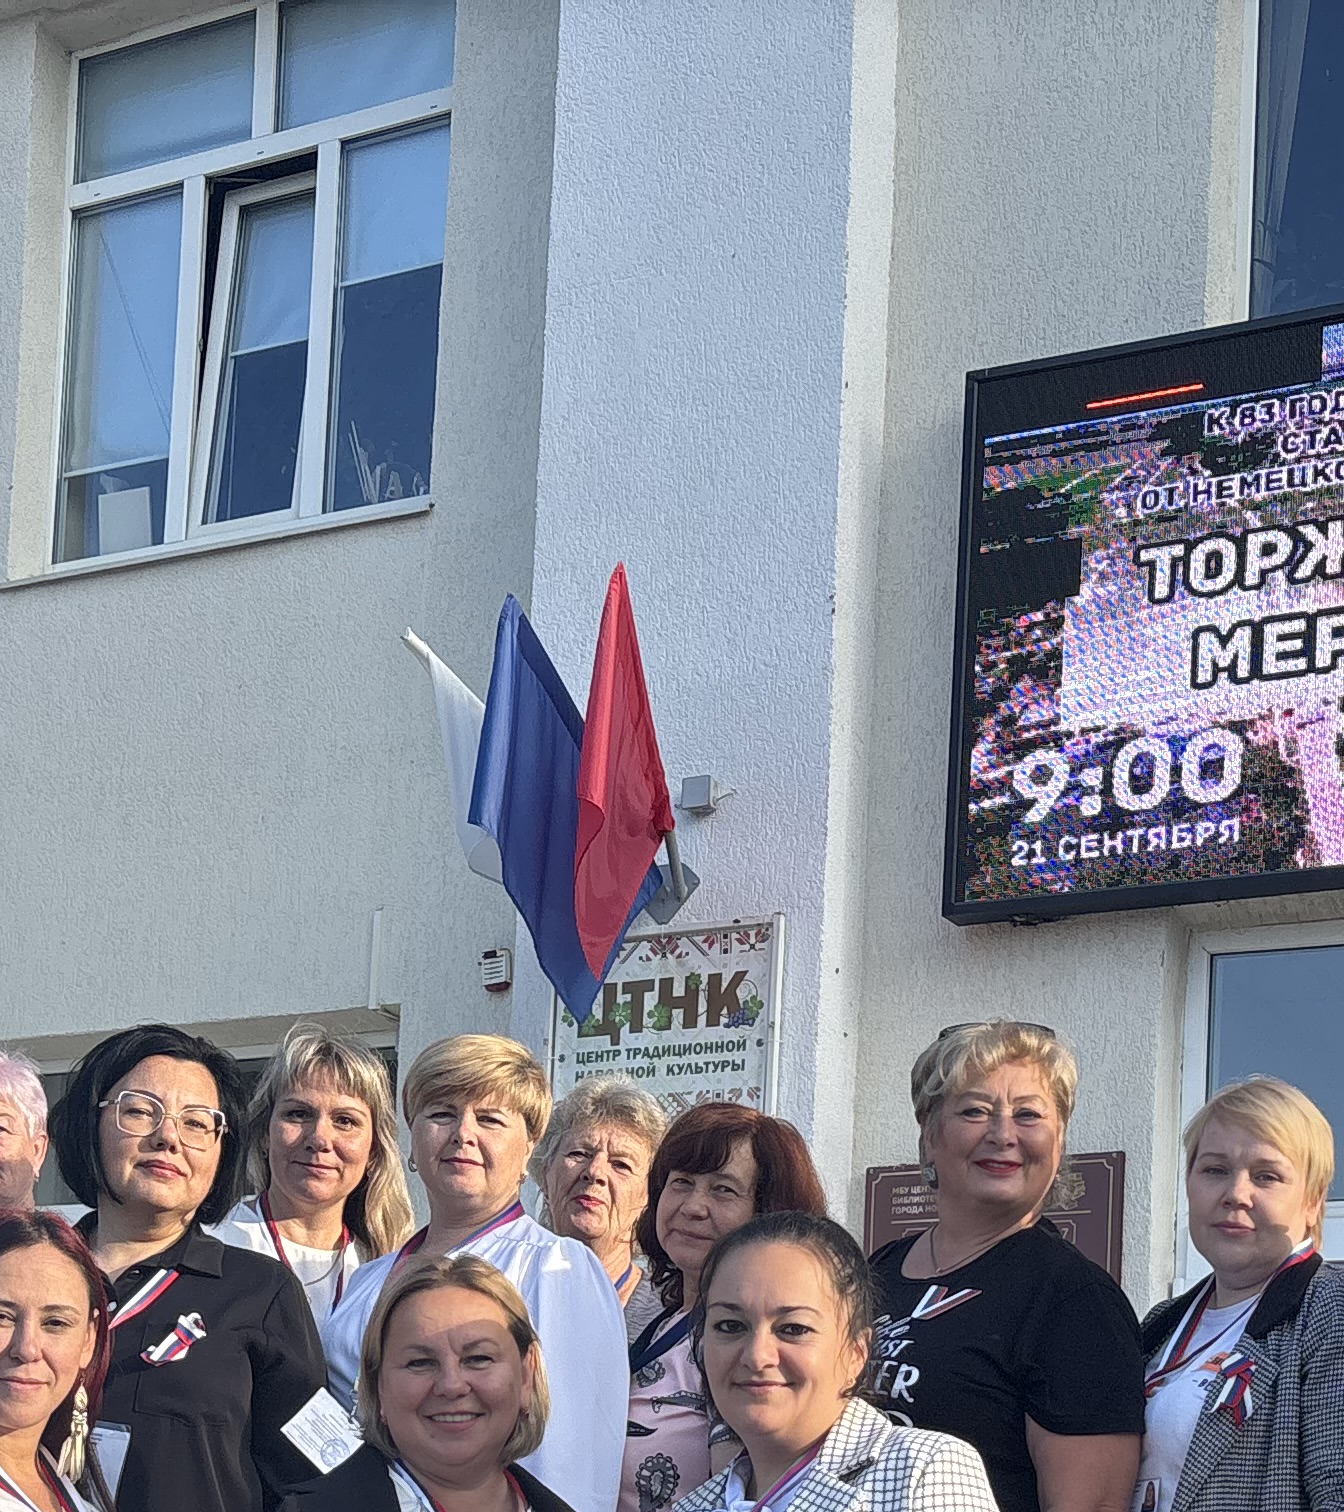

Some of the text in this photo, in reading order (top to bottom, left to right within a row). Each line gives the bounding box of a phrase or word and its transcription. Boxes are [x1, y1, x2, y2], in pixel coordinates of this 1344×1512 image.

[1139, 484, 1181, 513] ОТ
[1013, 728, 1244, 823] 9:00
[1011, 817, 1241, 867] 21 СЕНТЯБРЯ
[575, 1034, 748, 1066] ЦЕНТР ТРАДИЦИОННОЙ
[665, 1058, 746, 1077] КУЛЬТУРЫ
[891, 1204, 924, 1215] ГОРОДА
